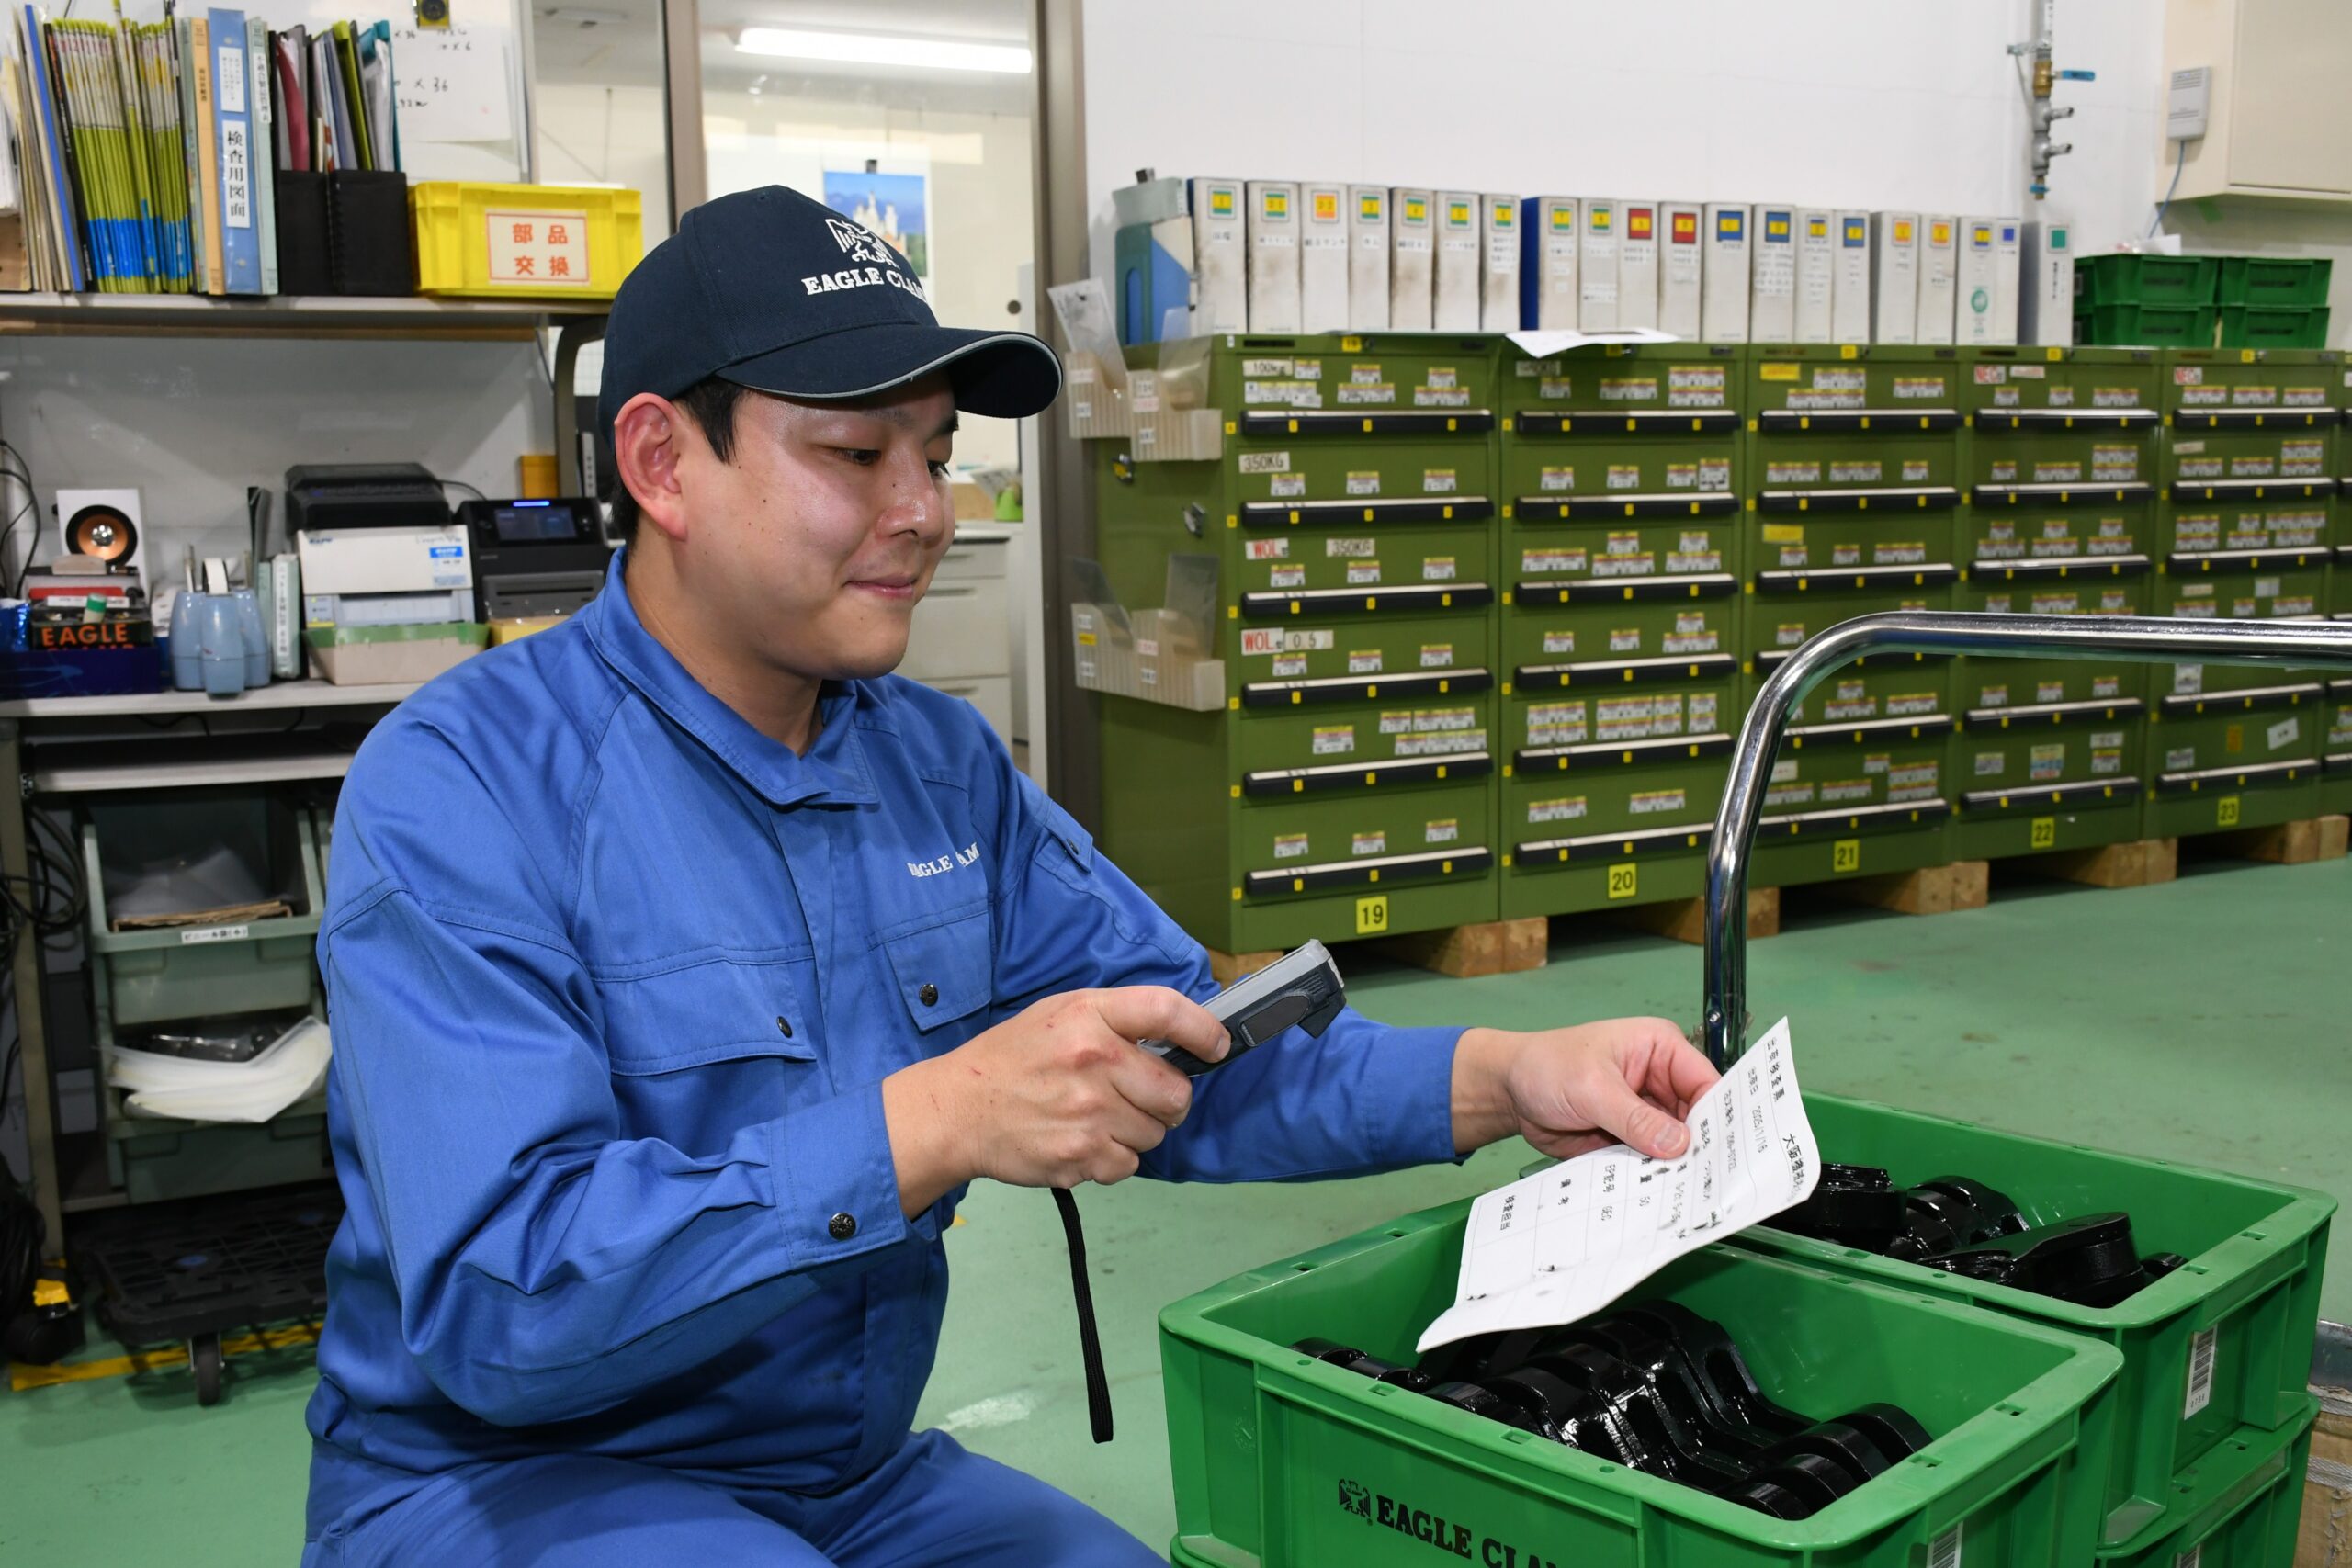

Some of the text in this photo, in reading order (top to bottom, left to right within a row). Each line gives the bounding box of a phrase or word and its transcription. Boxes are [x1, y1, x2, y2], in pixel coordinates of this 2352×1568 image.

[226, 129, 247, 218] 検査用図面
[511, 221, 568, 245] 部品
[514, 255, 571, 277] 交換
[801, 267, 885, 296] EAGLE
[41, 623, 129, 647] EAGLE
[2219, 802, 2238, 821] 23
[2033, 823, 2053, 843] 22
[1837, 847, 1855, 865] 21
[1611, 871, 1634, 892] 20
[1361, 904, 1384, 925] 19
[1766, 1037, 1785, 1102] 出荷検査票
[1751, 1104, 1768, 1154] 2025/1/16
[1375, 1495, 1473, 1560] EAGLE
